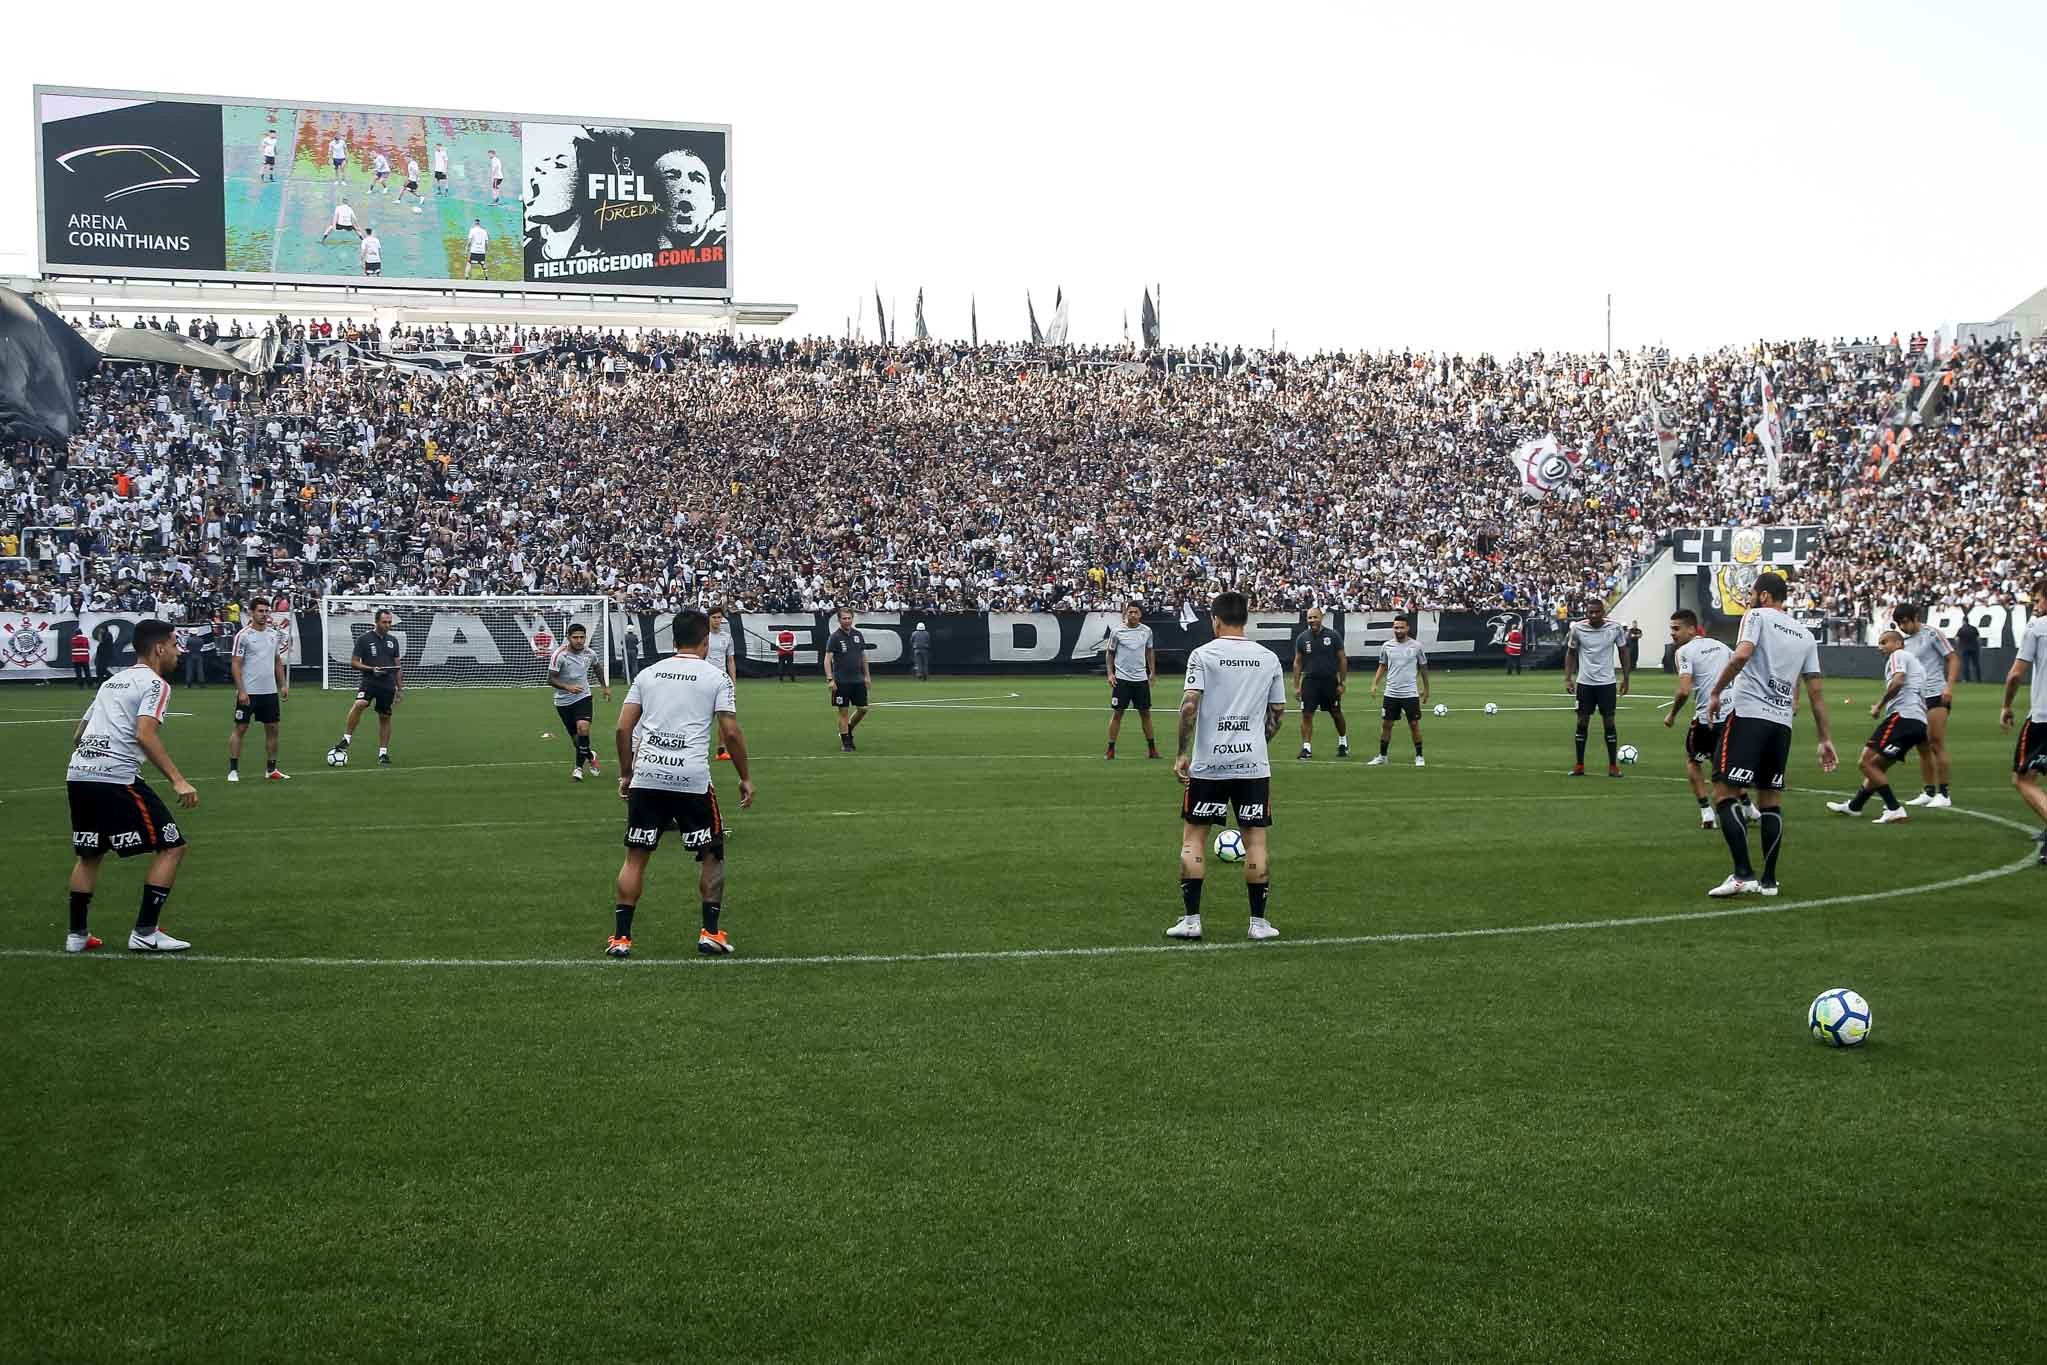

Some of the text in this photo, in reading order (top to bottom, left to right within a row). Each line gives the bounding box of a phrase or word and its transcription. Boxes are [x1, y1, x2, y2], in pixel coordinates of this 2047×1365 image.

[588, 174, 654, 201] FIEL
[68, 213, 128, 230] ARENA
[594, 200, 665, 231] TORCEDOR
[68, 231, 190, 251] CORINTHIANS
[533, 246, 725, 279] FIELTORCEDOR.COM.BR
[1219, 659, 1260, 667] POSITIVO
[655, 672, 697, 681] POSITIVO
[1217, 721, 1251, 731] BRASIL
[647, 735, 689, 749] BRASIL
[1212, 743, 1253, 754] FOXLUX
[642, 754, 685, 767] FOXLUX
[1206, 762, 1258, 770] MATRIX
[637, 772, 690, 782] MATRIX
